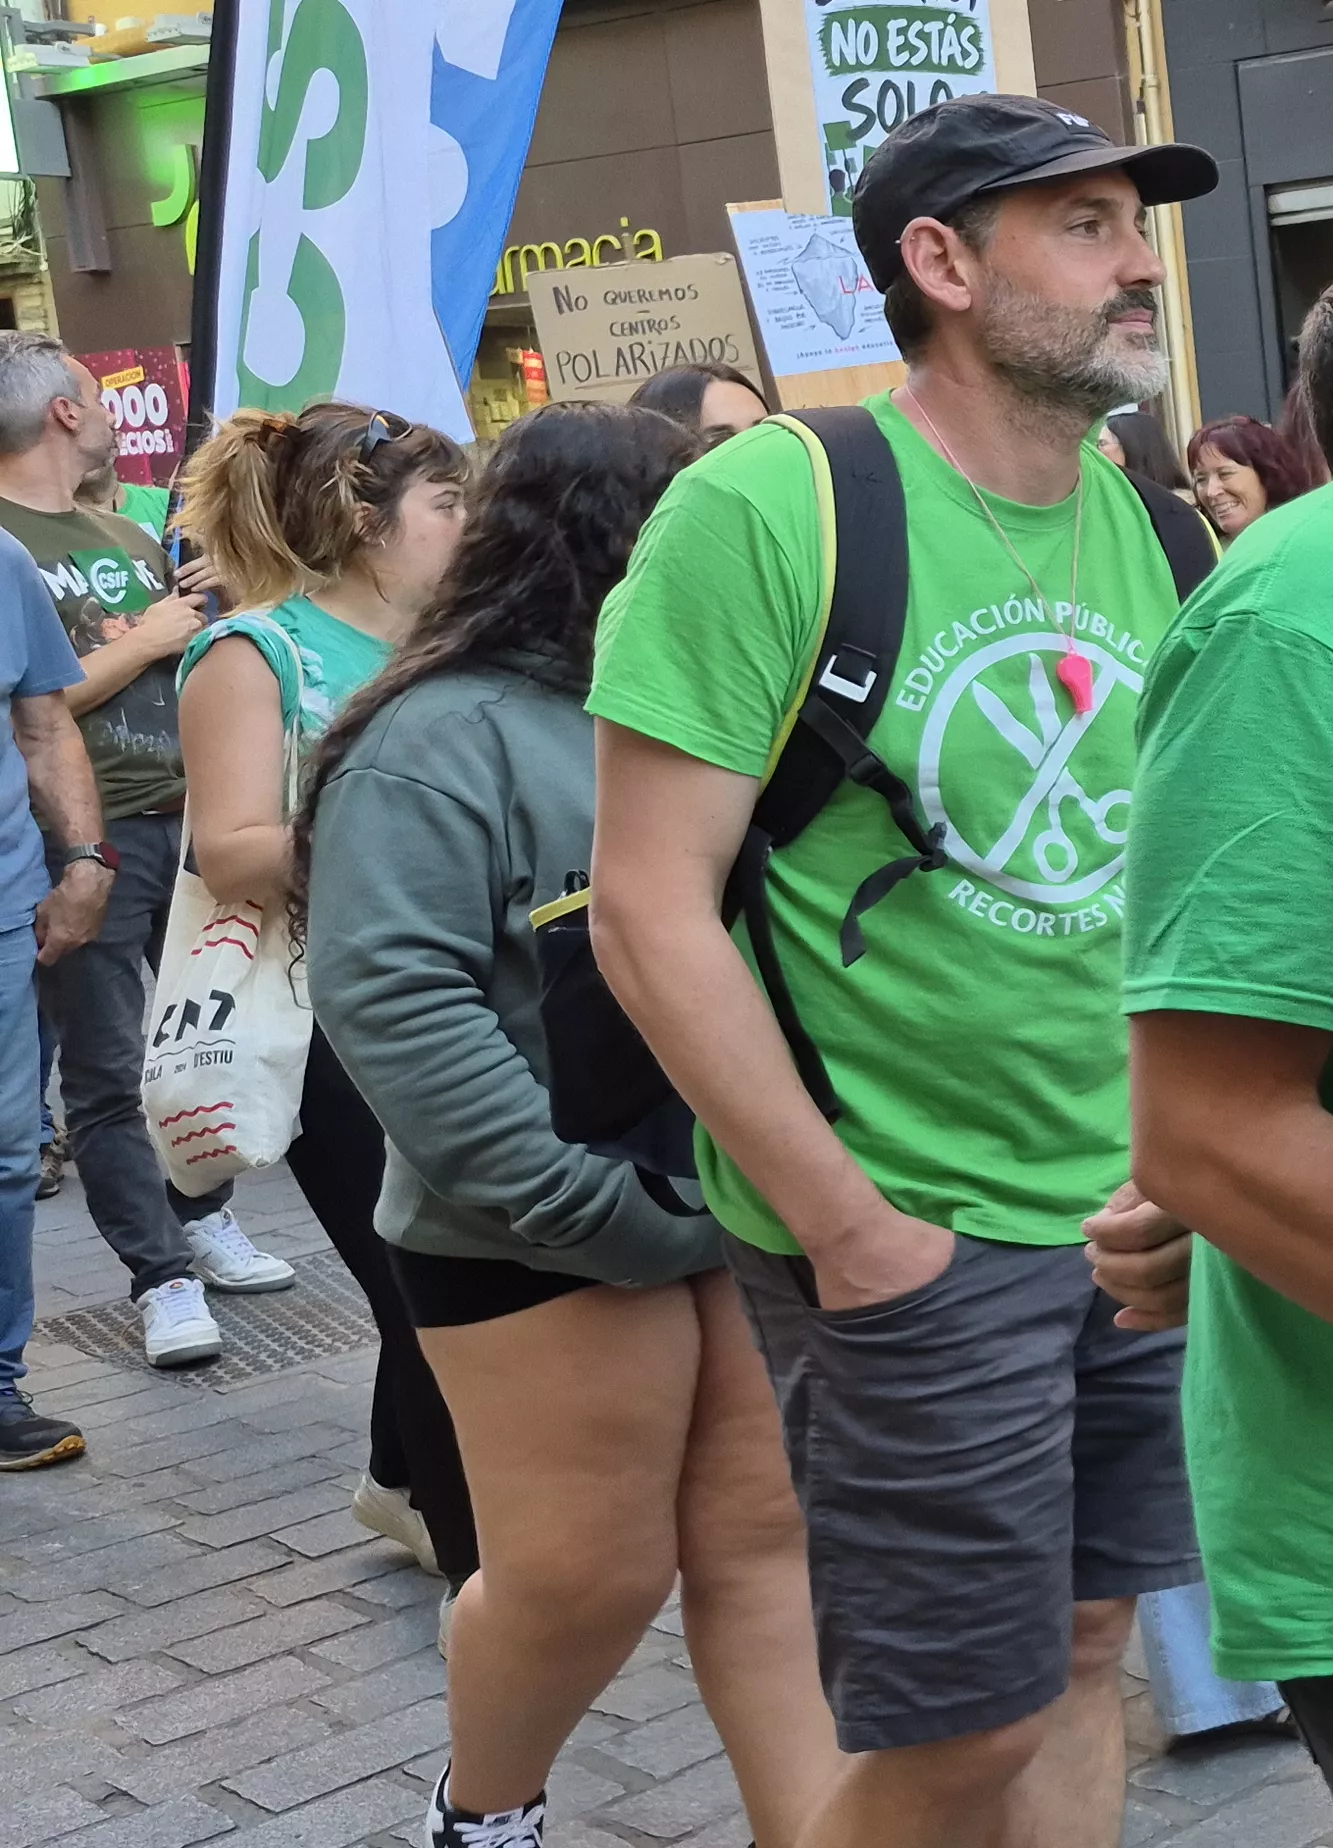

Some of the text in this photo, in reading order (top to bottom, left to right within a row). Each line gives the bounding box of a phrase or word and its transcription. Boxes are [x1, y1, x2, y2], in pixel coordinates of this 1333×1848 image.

[829, 13, 980, 69] NO ESTÁS
[603, 284, 700, 305] QUEREMOS
[609, 315, 682, 338] CENTROS
[97, 570, 129, 590] CSIF
[895, 594, 1149, 713] EDUCACIÓN PÚBLIC
[947, 878, 1108, 937] RECORTES
